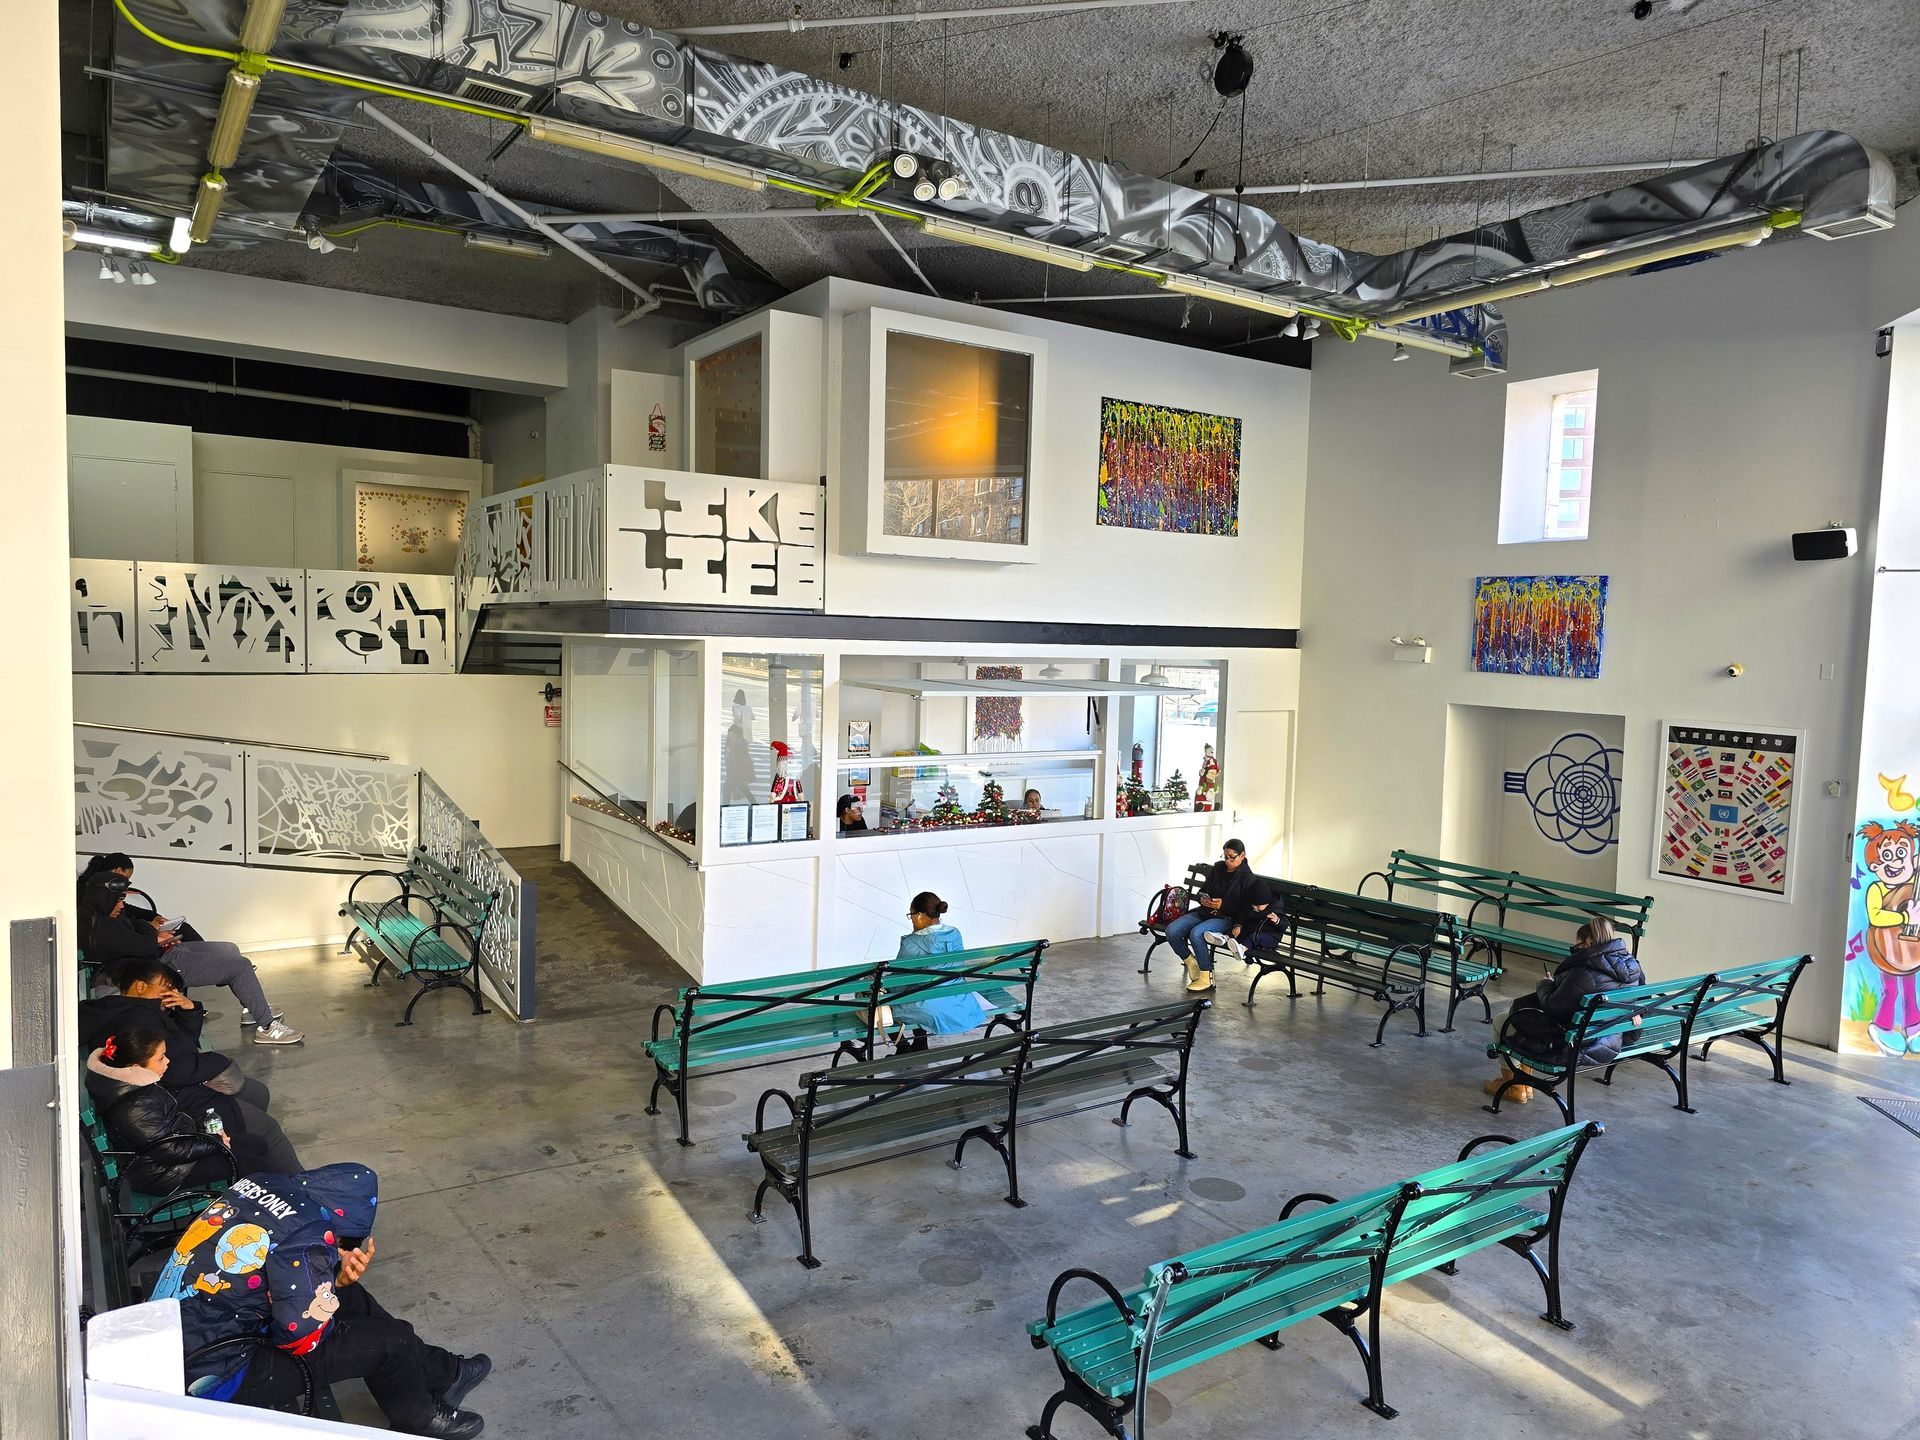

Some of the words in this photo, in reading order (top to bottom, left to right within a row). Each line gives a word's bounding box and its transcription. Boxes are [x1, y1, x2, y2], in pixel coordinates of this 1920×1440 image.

[612, 478, 816, 547] LIKE
[612, 530, 816, 595] LIFE
[257, 1193, 297, 1220] ONLY
